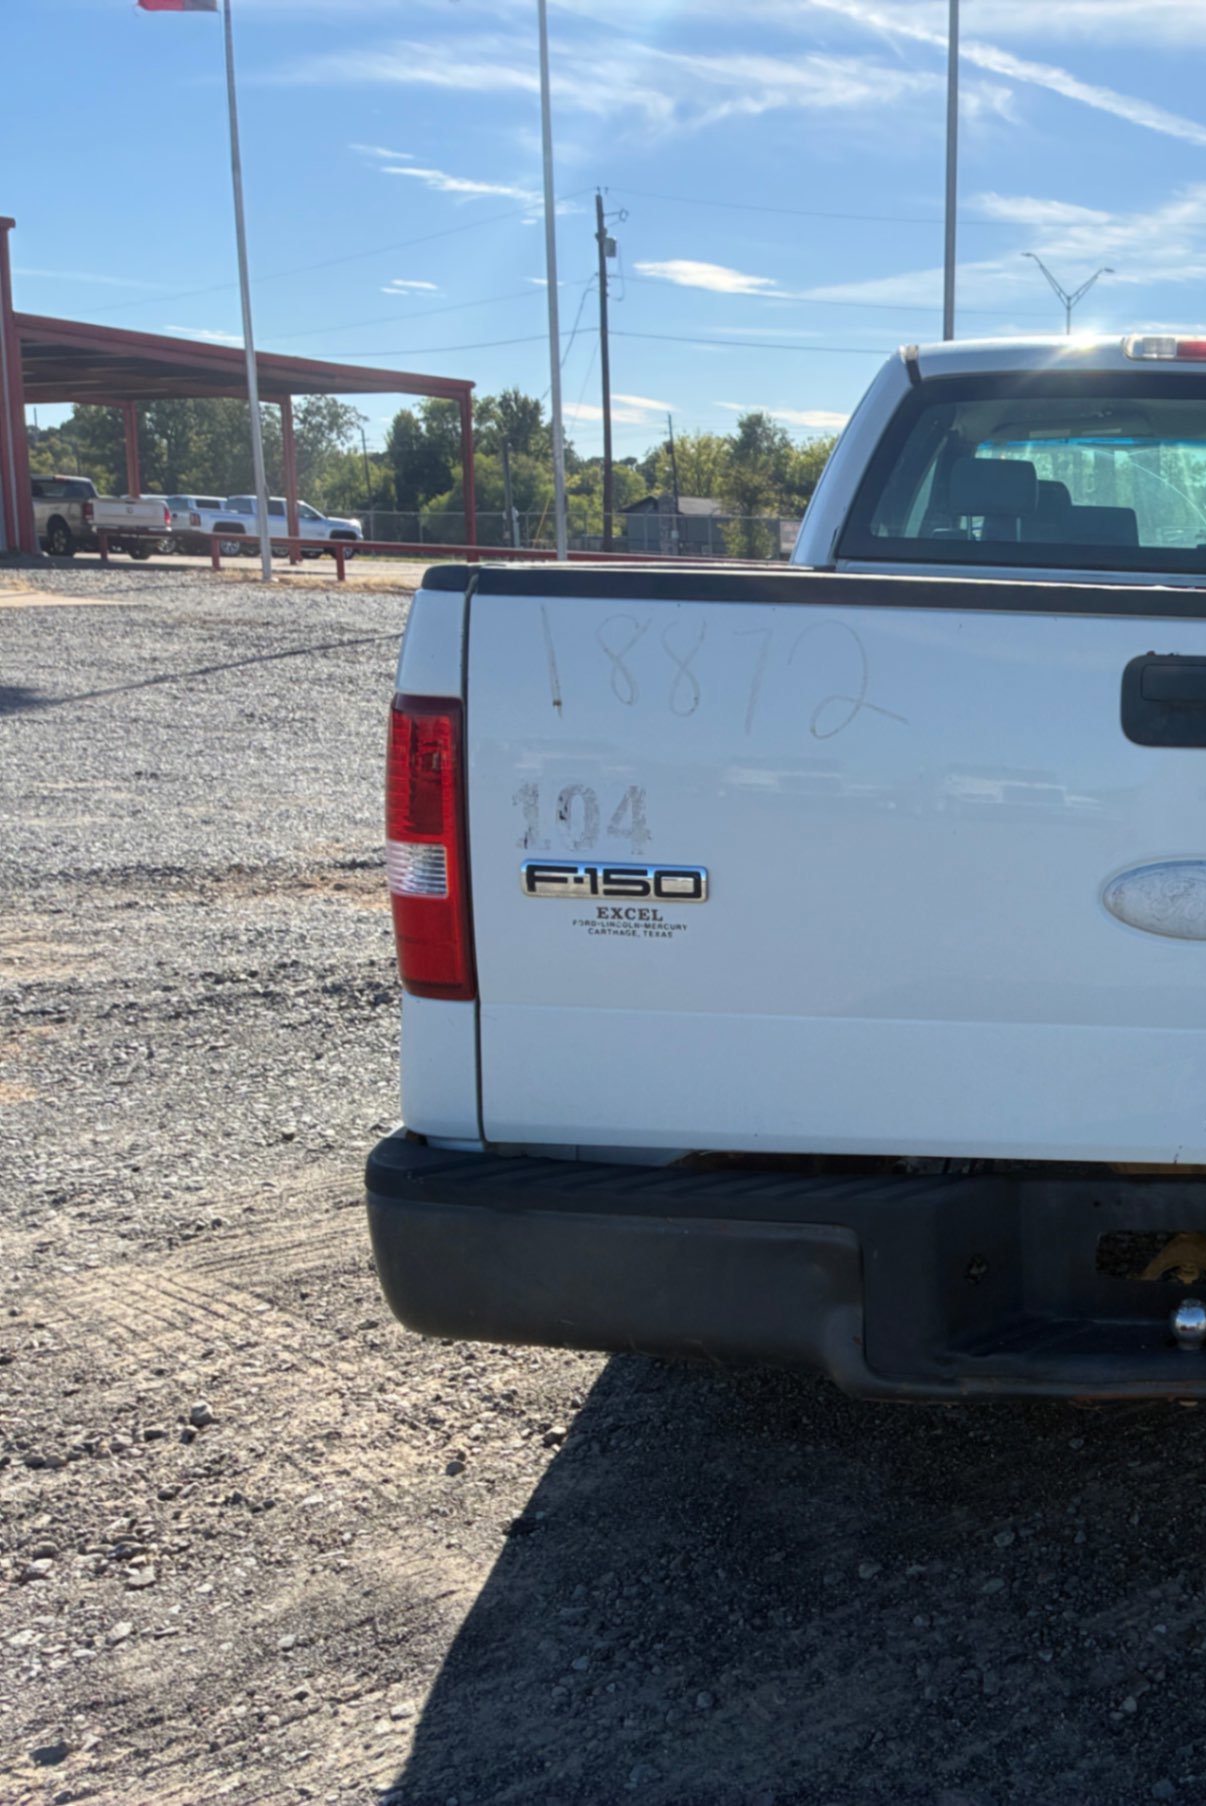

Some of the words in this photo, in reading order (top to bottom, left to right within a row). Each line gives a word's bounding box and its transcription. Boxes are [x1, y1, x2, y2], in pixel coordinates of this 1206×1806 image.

[540, 603, 909, 740] 18872
[512, 782, 652, 855] 104
[525, 863, 702, 899] F-150
[596, 906, 664, 922] EXCEL
[643, 930, 674, 938] TEXAS
